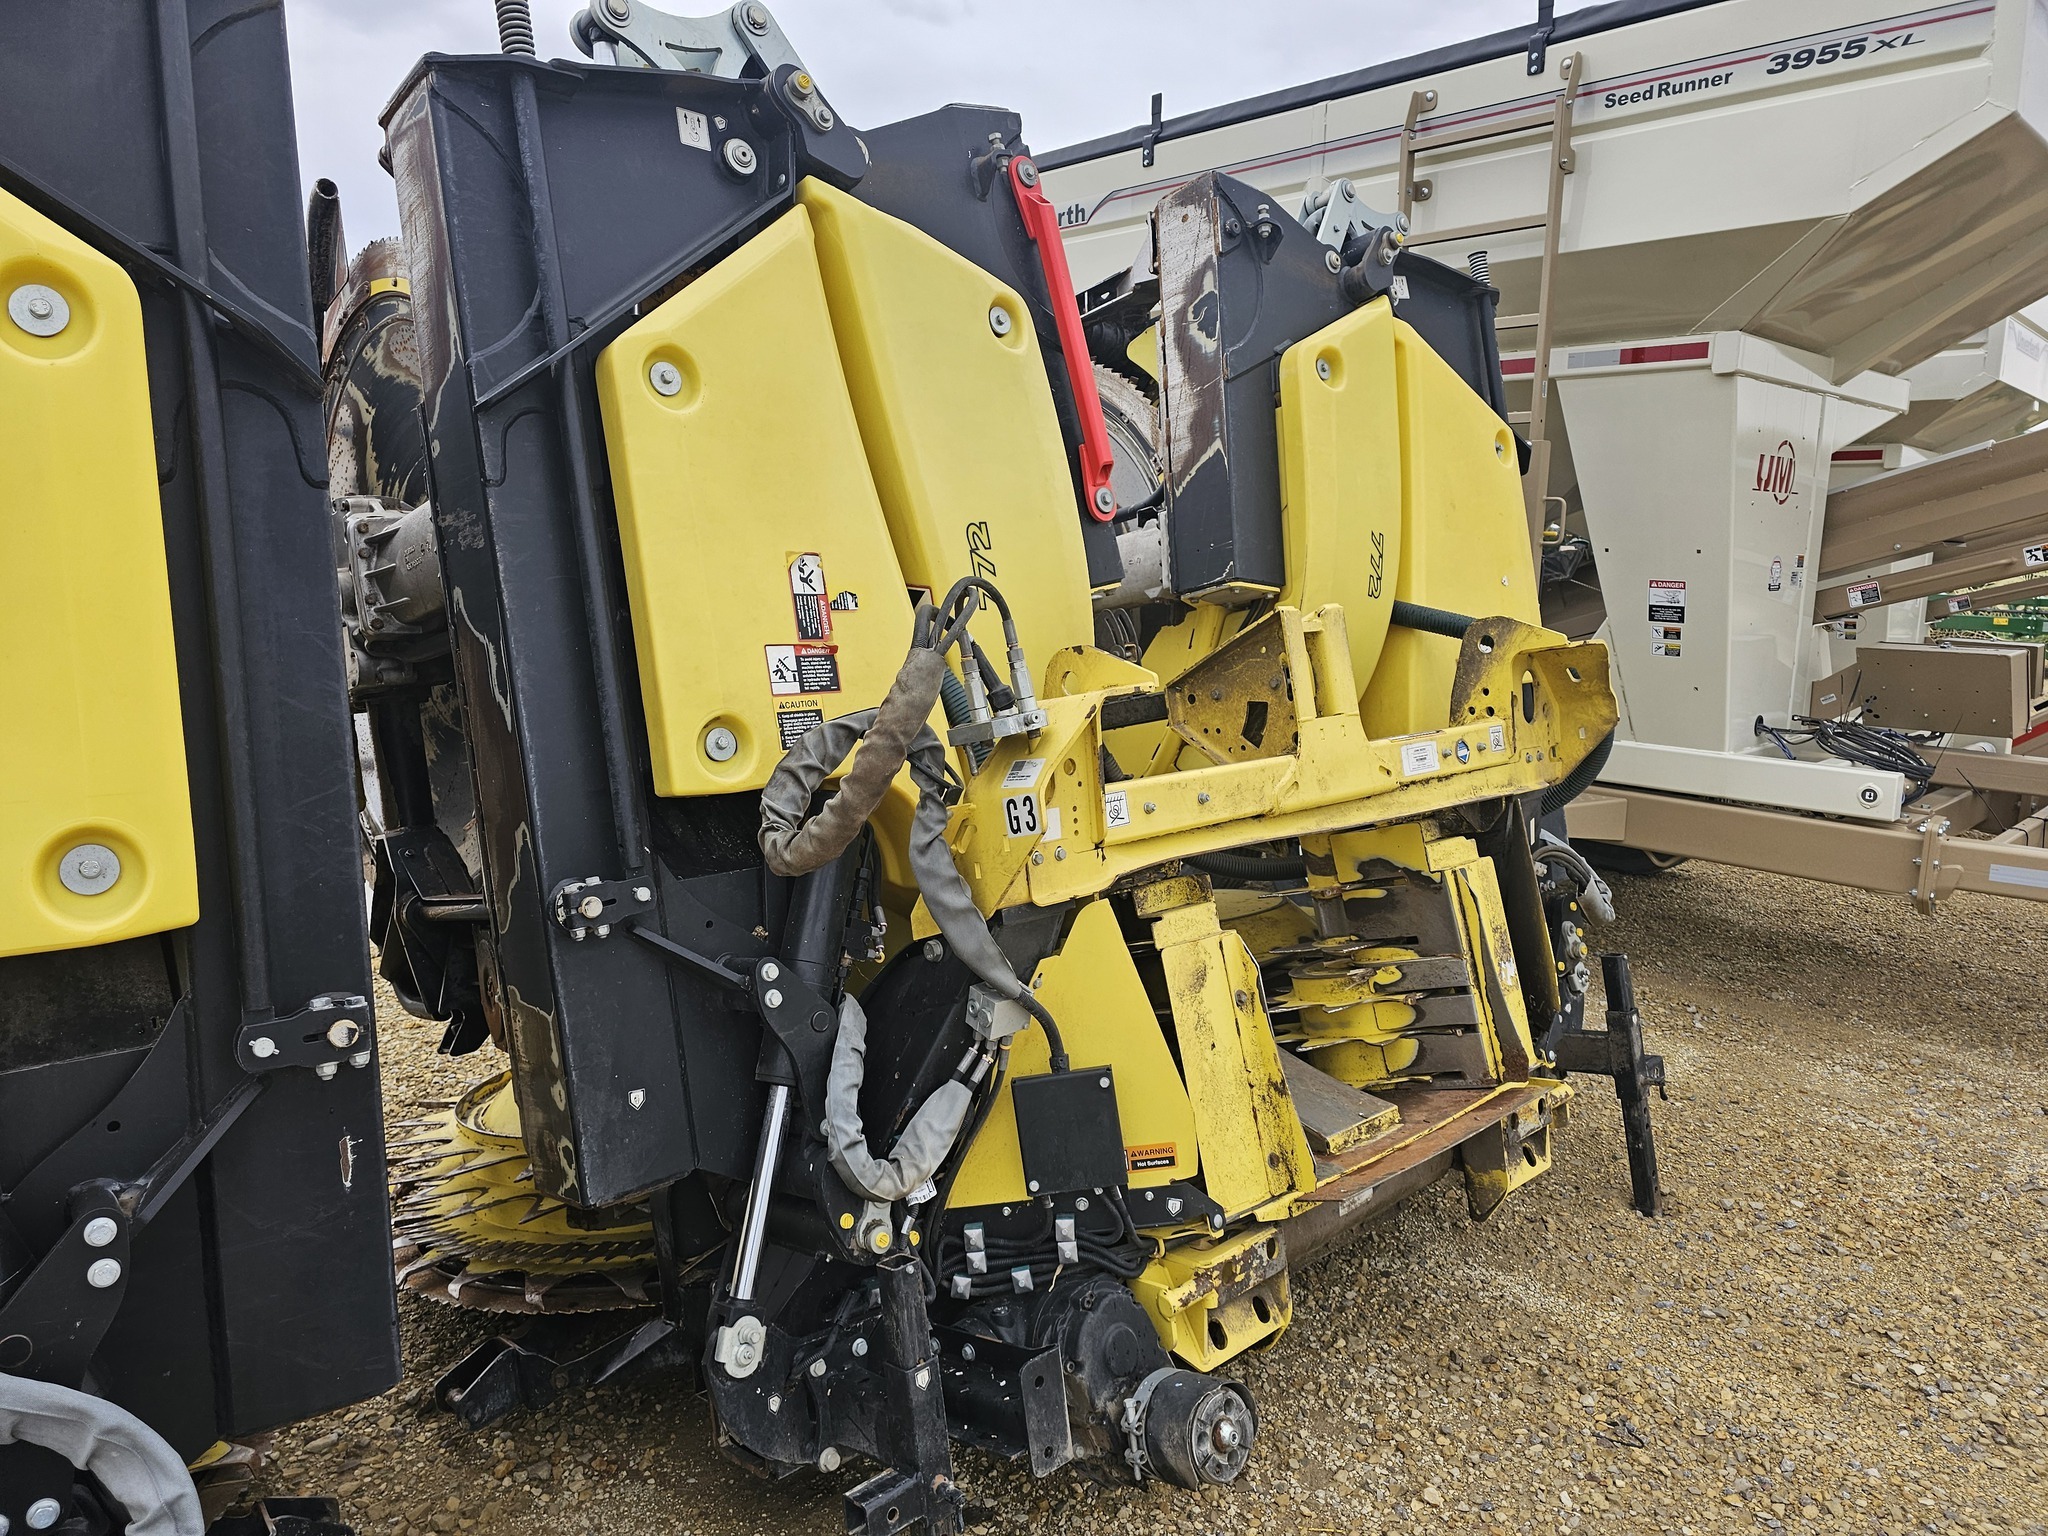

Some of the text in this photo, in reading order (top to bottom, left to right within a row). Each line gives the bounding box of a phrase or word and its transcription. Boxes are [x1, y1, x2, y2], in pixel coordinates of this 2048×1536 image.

[1766, 33, 1926, 75] 3955 XL
[1604, 71, 1734, 109] Seed Runner
[1367, 530, 1384, 599] 772
[1658, 581, 1685, 589] DANGER
[820, 605, 830, 635] DANGER
[785, 699, 818, 709] CAUTION
[1006, 795, 1037, 835] G3
[1137, 1147, 1173, 1156] WARNING
